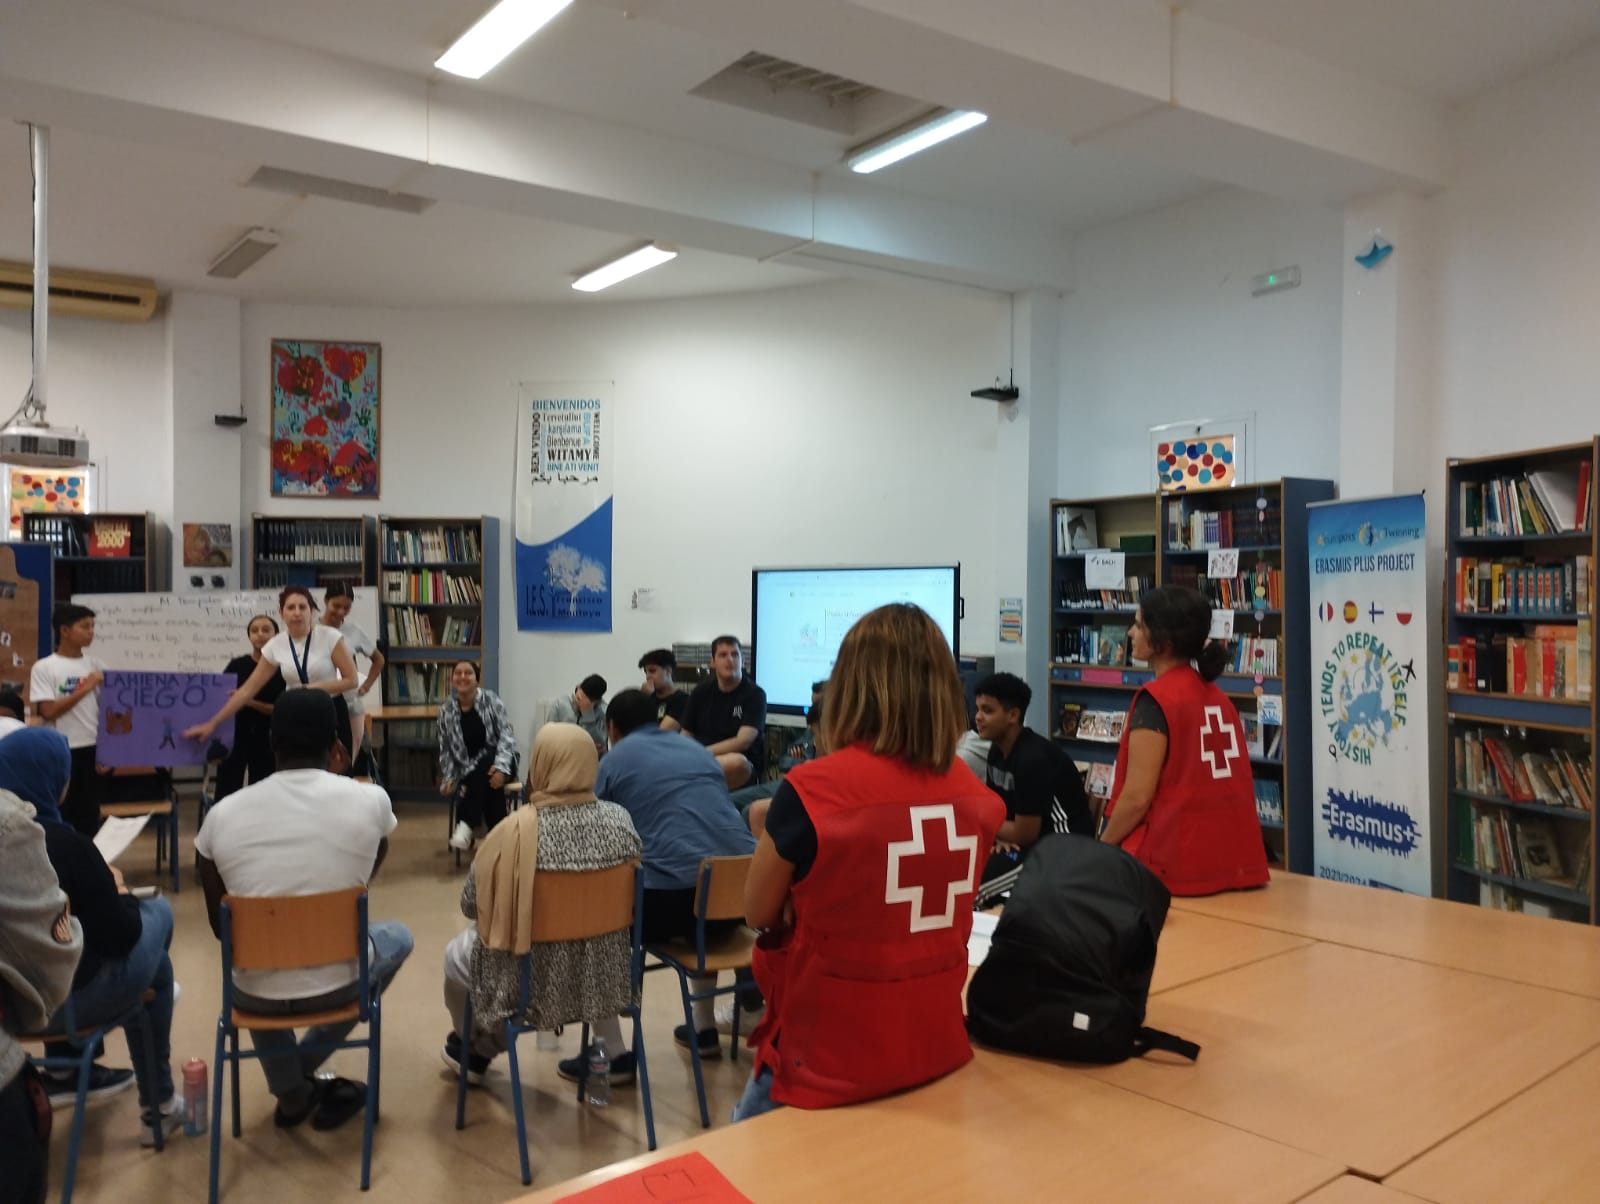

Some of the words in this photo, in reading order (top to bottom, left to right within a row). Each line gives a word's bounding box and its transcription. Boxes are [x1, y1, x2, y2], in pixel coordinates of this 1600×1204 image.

[532, 399, 601, 411] BIENVENIDOS
[547, 448, 592, 462] WITAMY
[1315, 556, 1352, 574] ERASMUS
[1354, 555, 1375, 572] PLUS
[1377, 553, 1416, 571] PROJECT
[1320, 660, 1338, 718] TENDS
[1332, 640, 1346, 661] TO
[1346, 631, 1393, 661] REPEAT
[117, 685, 206, 709] CIEGO
[1330, 803, 1415, 844] Erasmus+
